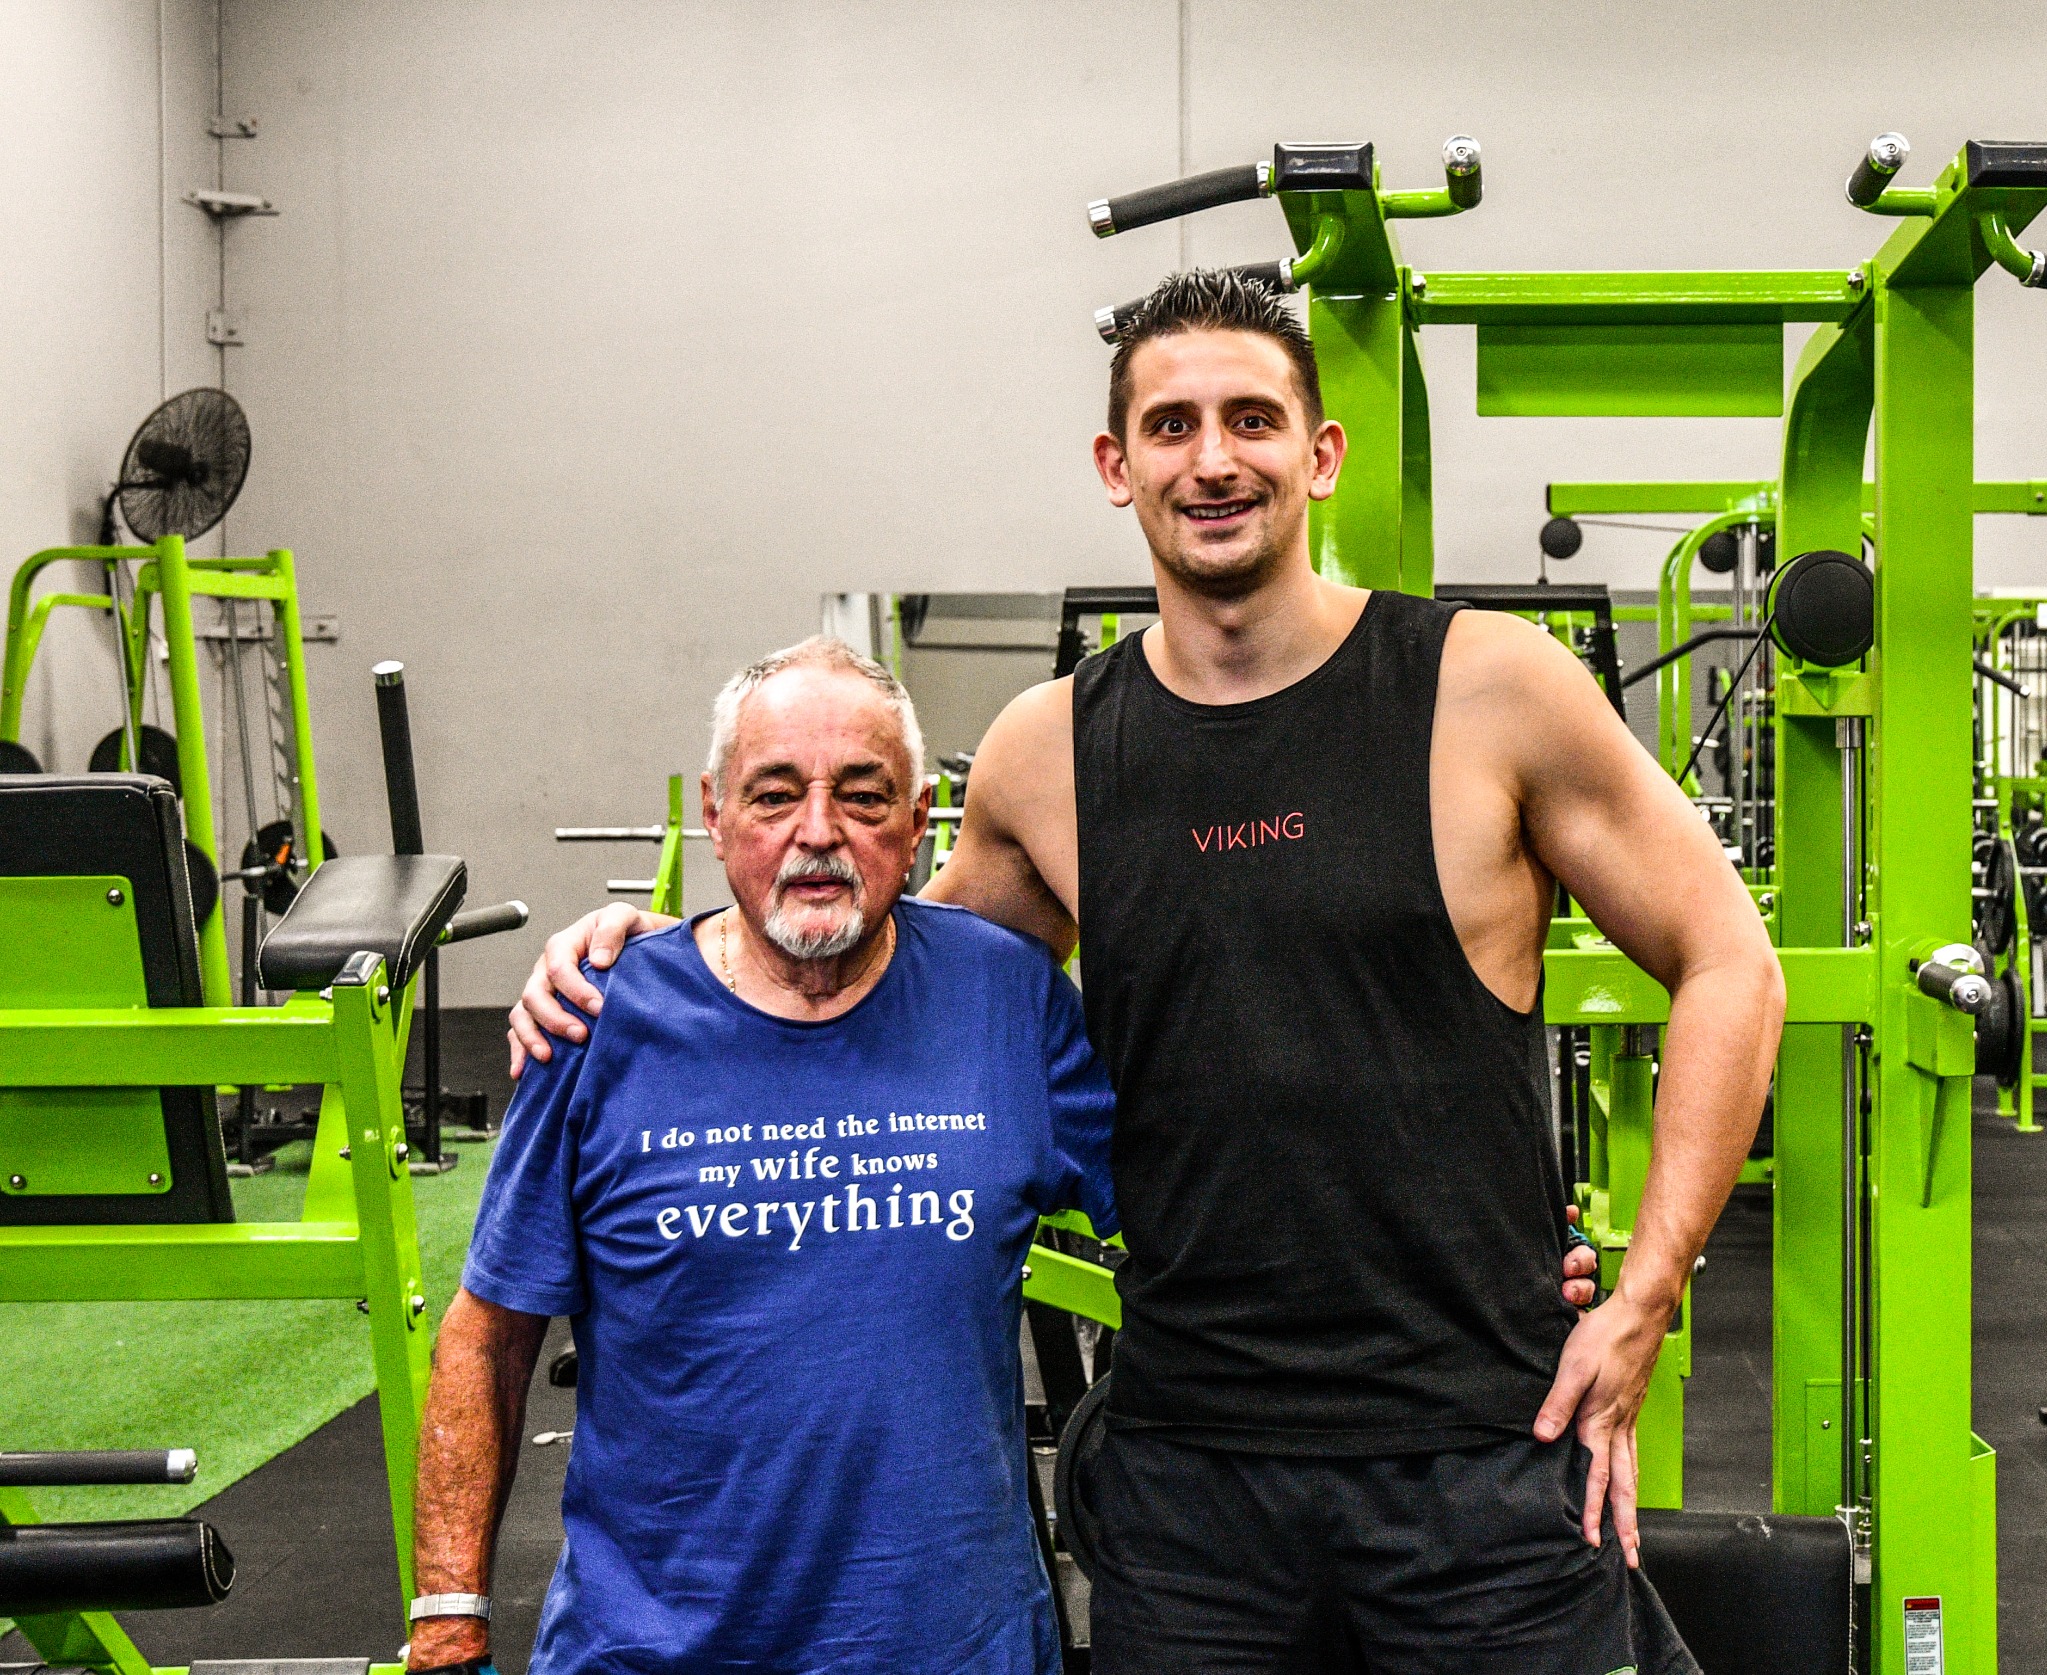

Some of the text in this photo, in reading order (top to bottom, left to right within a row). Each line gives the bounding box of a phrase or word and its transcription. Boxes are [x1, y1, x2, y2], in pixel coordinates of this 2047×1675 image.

[1190, 811, 1305, 853] VIKING
[640, 1111, 986, 1153] I do not need the internet
[698, 1146, 939, 1188] my wife knows
[656, 1182, 976, 1252] everything
